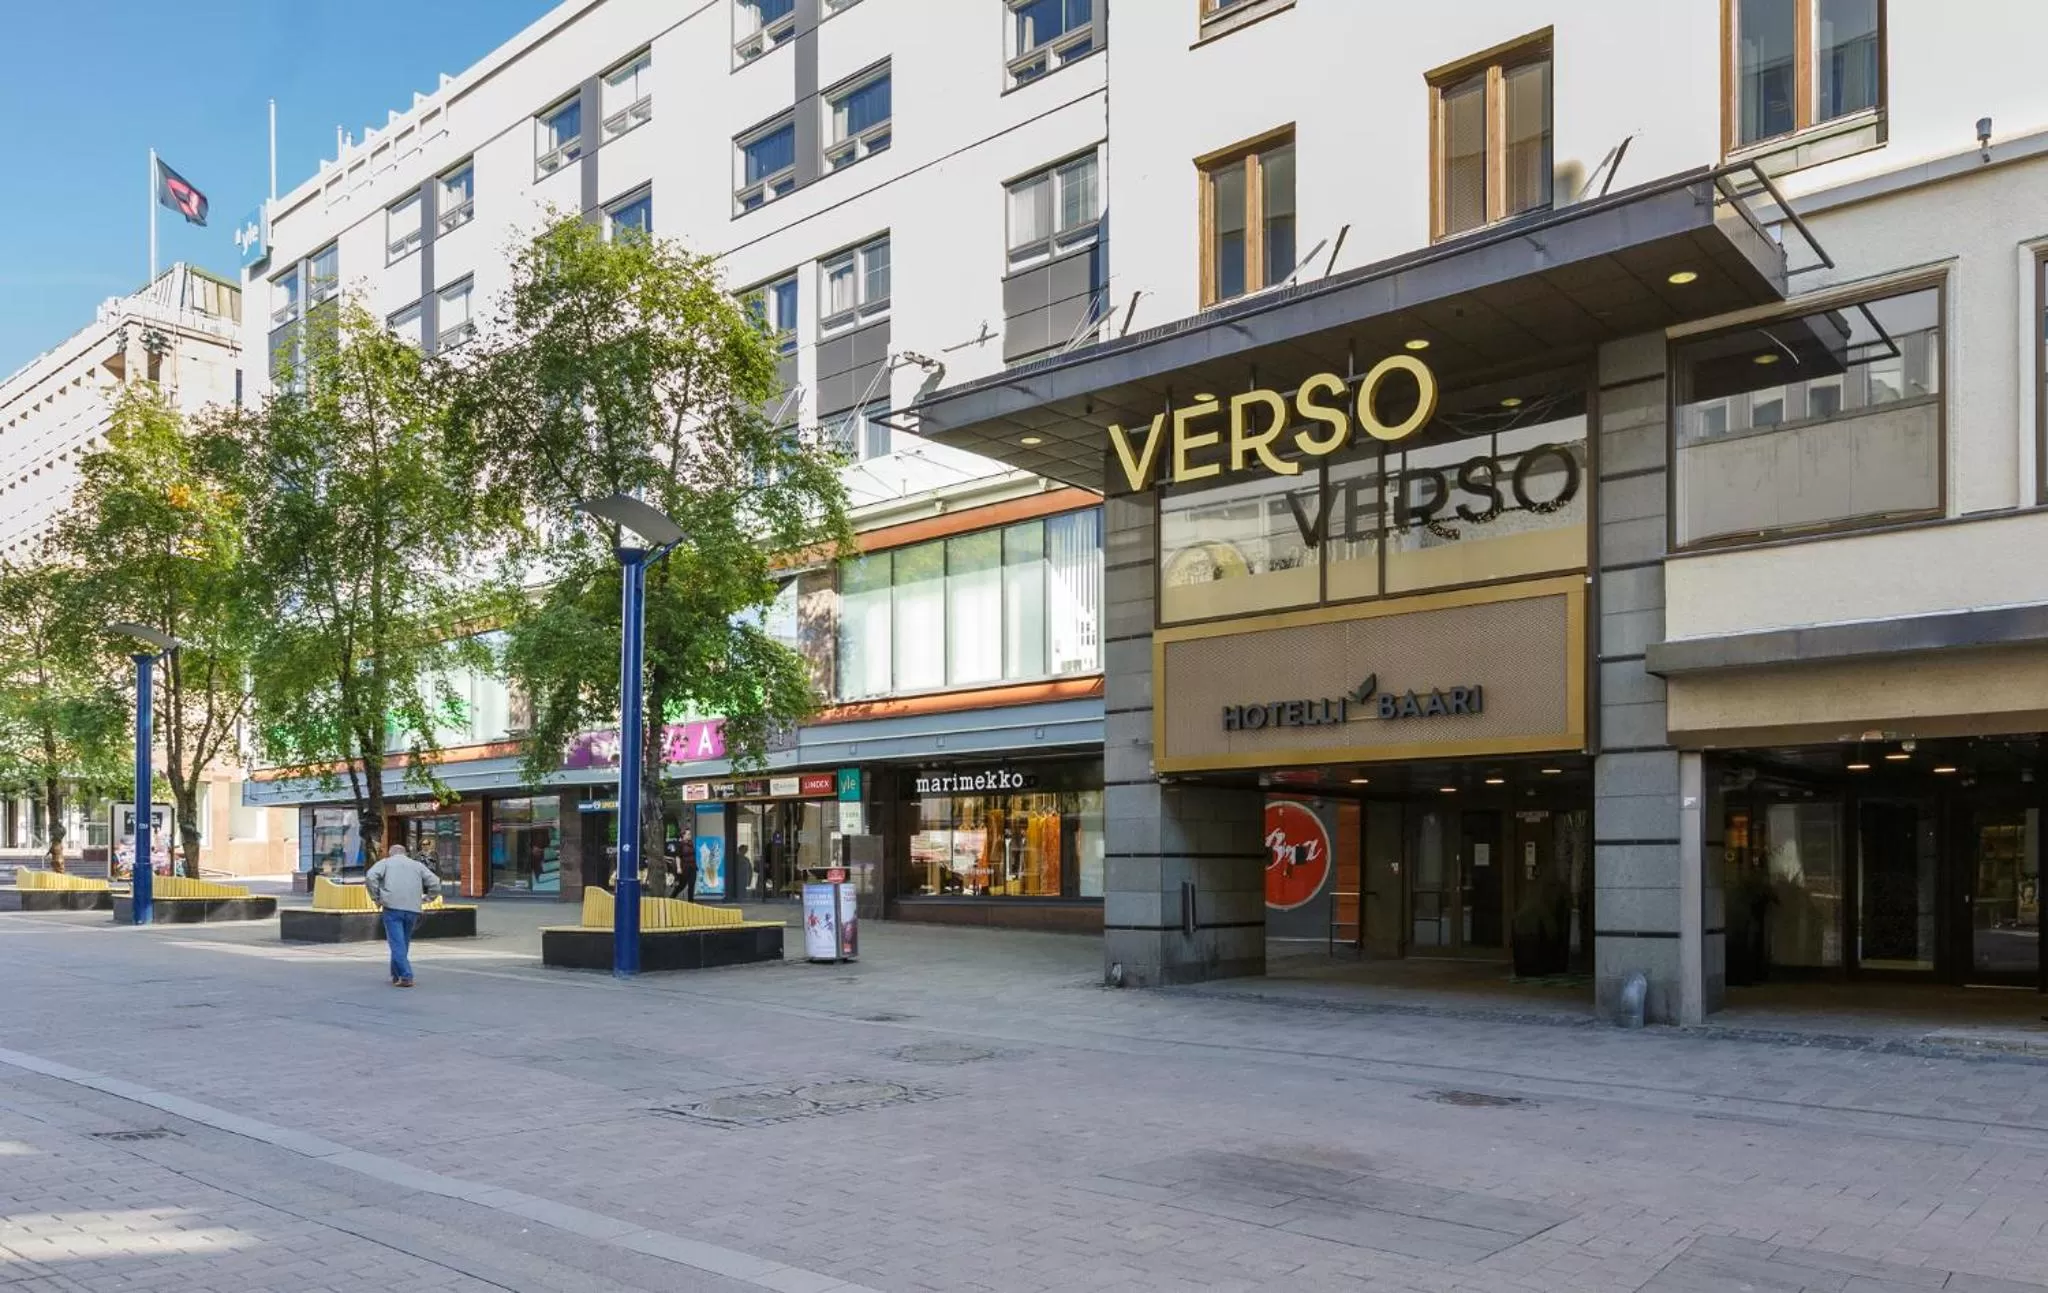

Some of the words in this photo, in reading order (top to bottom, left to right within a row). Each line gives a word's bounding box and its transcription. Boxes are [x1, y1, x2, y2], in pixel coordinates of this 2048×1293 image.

[1108, 355, 1438, 492] VERSO
[1222, 696, 1347, 731] HOTELLI
[1376, 684, 1483, 720] BAARI
[804, 780, 830, 789] LINDEX
[840, 775, 857, 794] yle
[916, 770, 1023, 793] marimekko
